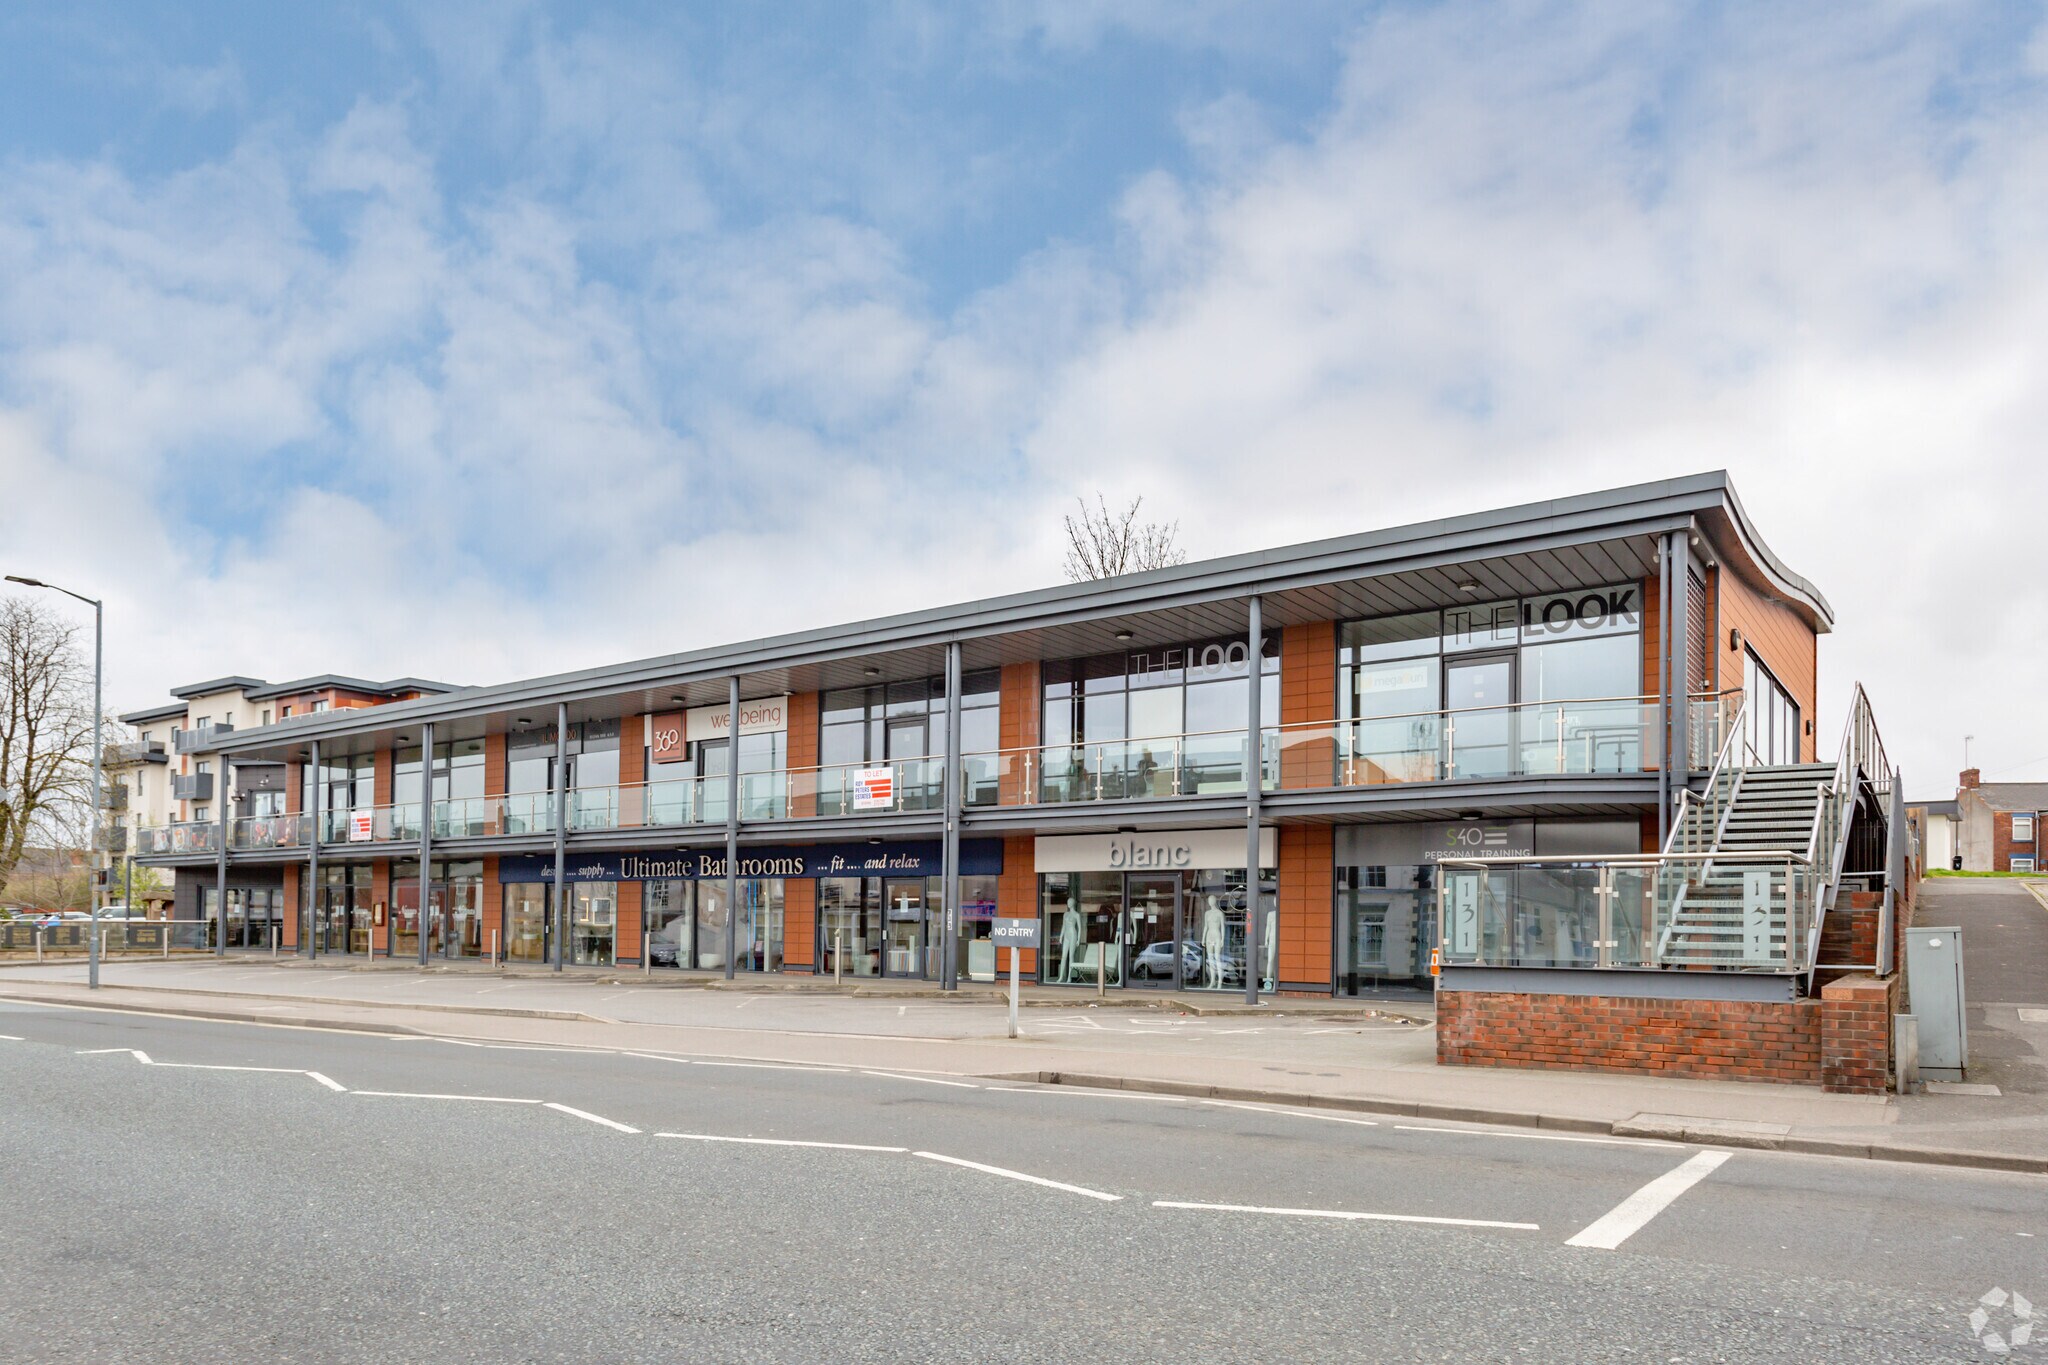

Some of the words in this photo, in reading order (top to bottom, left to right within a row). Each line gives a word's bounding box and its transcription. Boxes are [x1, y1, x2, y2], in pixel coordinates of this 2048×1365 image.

[1446, 605, 1516, 645] THE
[1523, 589, 1638, 637] LOOK
[1130, 649, 1181, 682] THE
[1187, 637, 1271, 676] LOOK
[1374, 673, 1424, 688] megaun
[711, 704, 781, 729] webeing
[654, 729, 679, 752] 360
[864, 770, 871, 778] TO
[873, 769, 883, 777] LET
[1446, 827, 1483, 846] S40
[1110, 840, 1191, 869] blanc
[1424, 850, 1475, 860] PERSONAL
[1480, 849, 1531, 858] TRAINING
[541, 864, 566, 880] desi
[578, 863, 605, 879] supply
[620, 856, 692, 879] Ultimate
[830, 855, 845, 873] fit
[864, 854, 887, 869] and
[889, 853, 921, 869] relax
[994, 927, 1007, 936] NO
[1008, 928, 1034, 937] ENTRY
